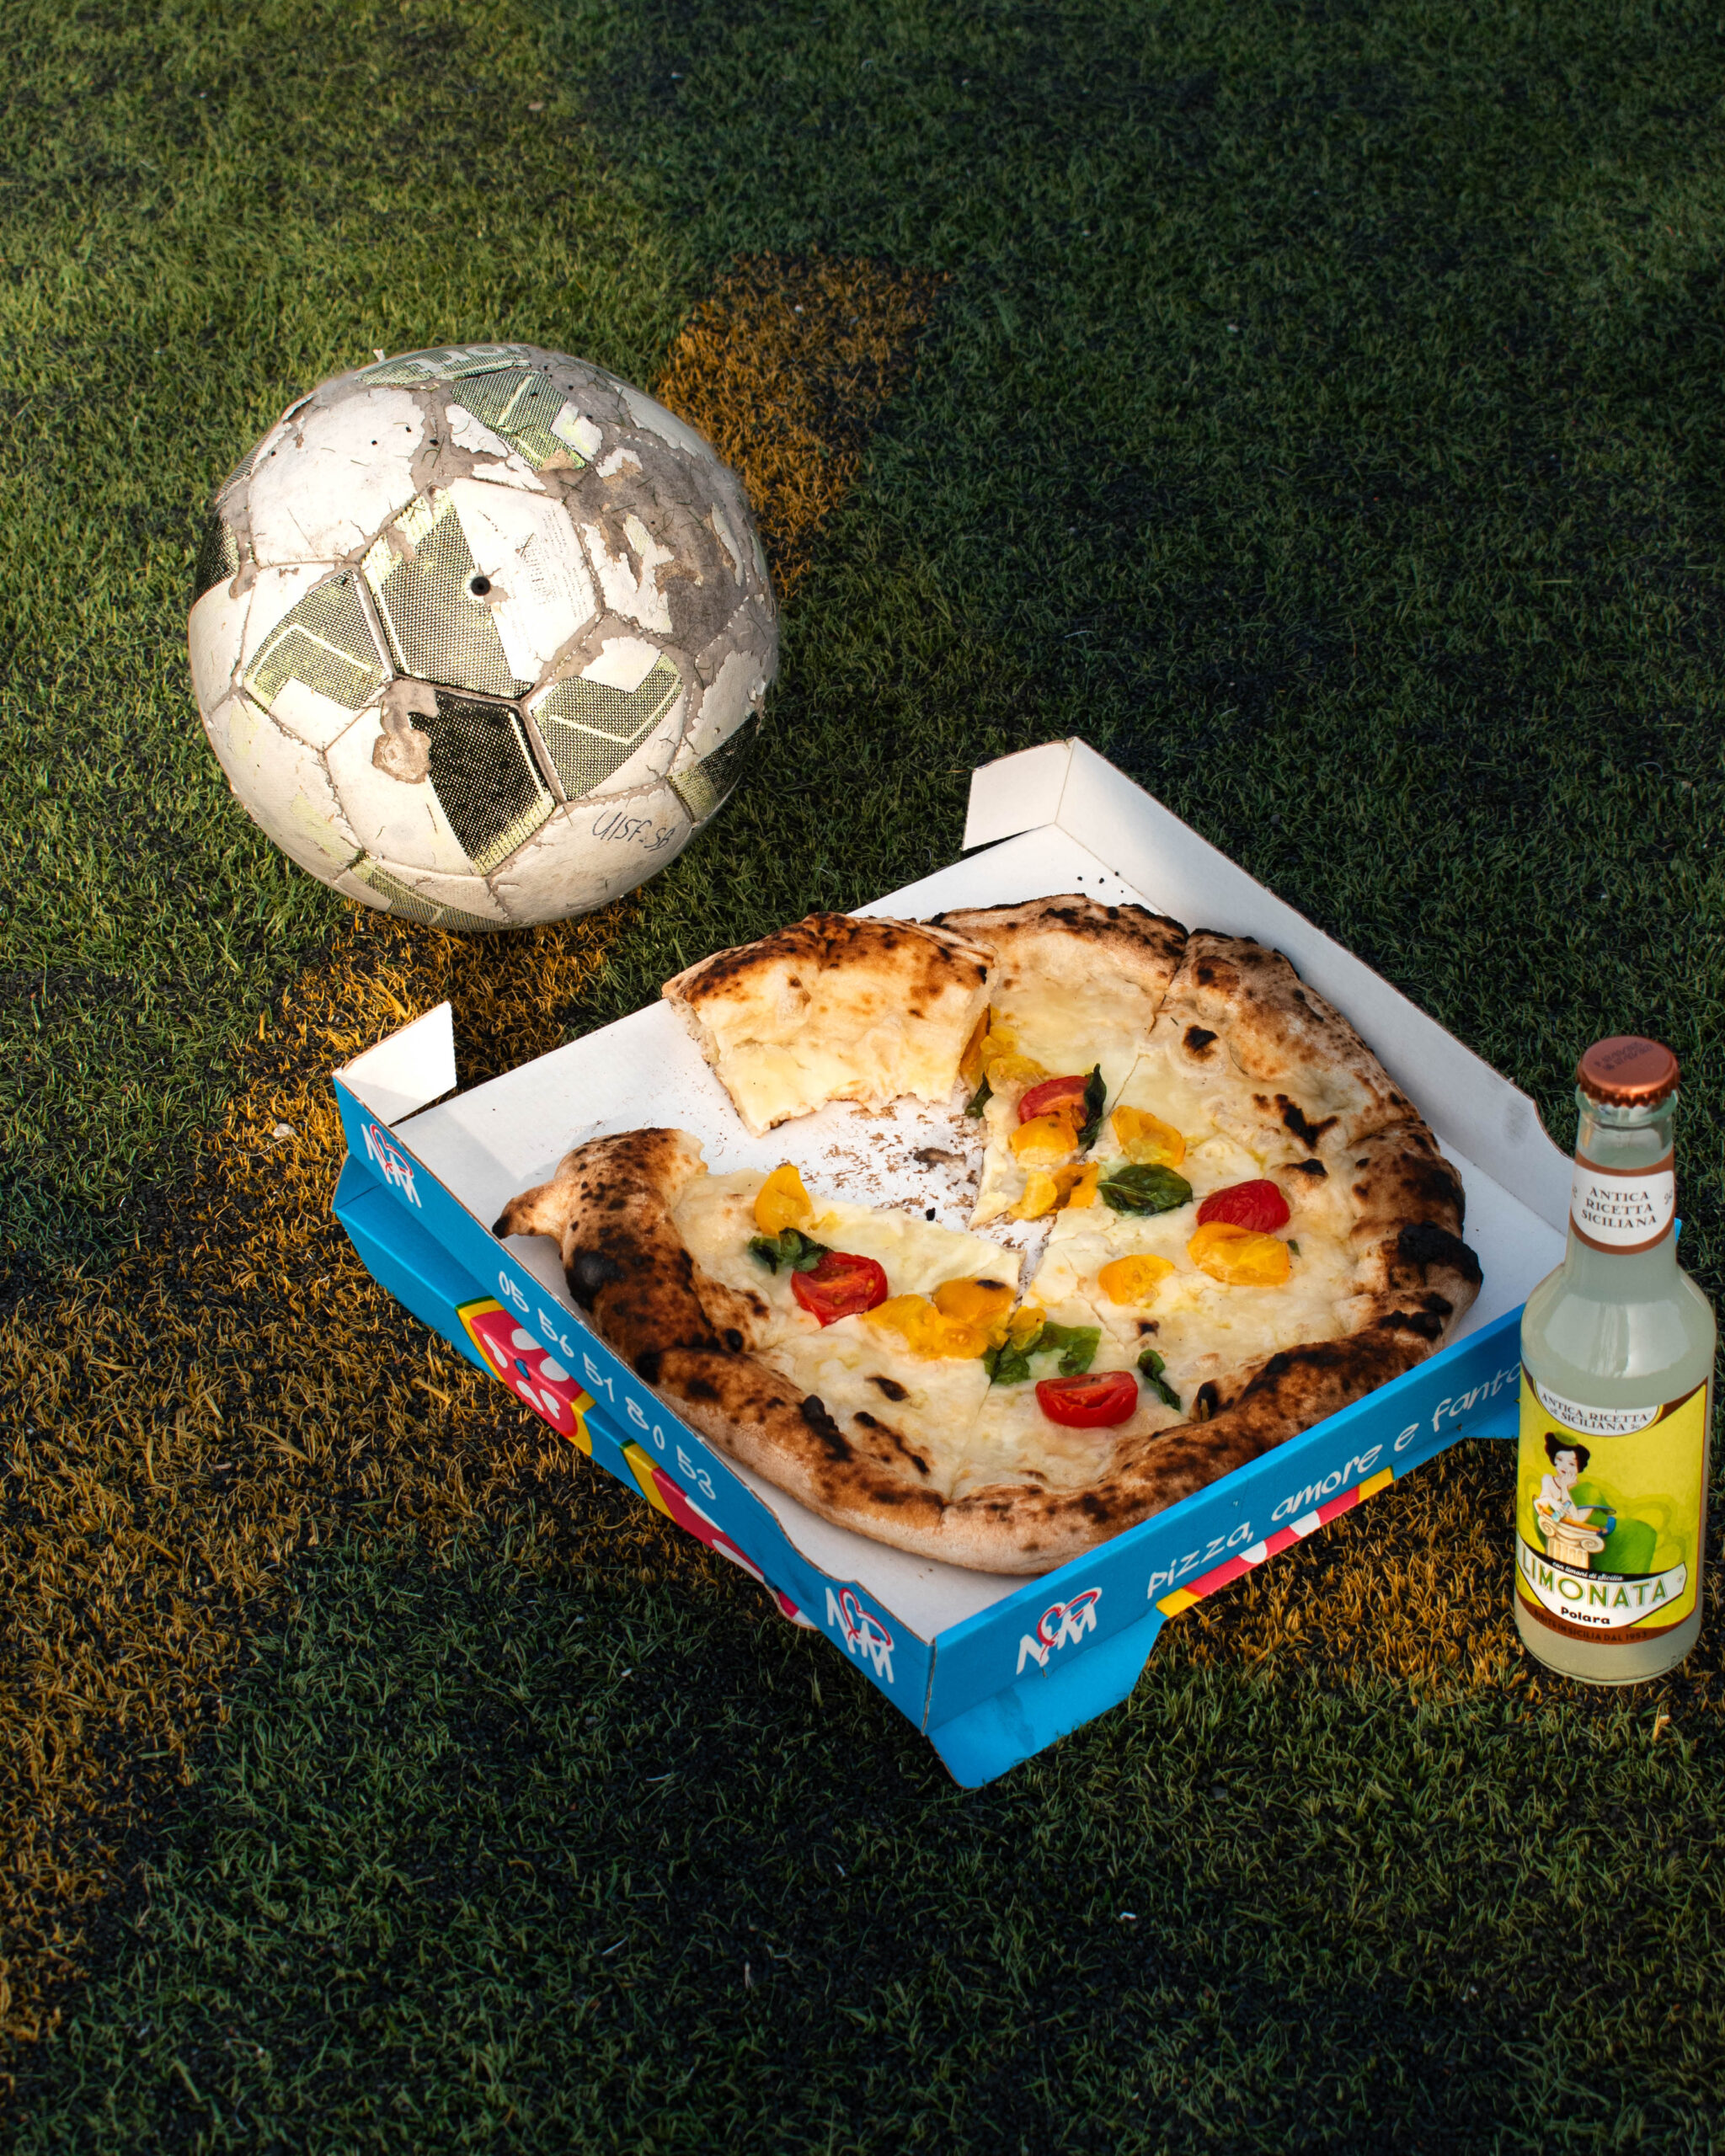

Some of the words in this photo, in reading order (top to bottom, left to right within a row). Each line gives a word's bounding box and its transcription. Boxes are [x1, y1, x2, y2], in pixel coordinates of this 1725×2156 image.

[1589, 1186, 1649, 1202] ANTICA
[1585, 1198, 1653, 1214] RICETTA
[1581, 1209, 1657, 1228] SICILIANA
[499, 1271, 530, 1313] 05
[538, 1308, 574, 1358] 56
[583, 1353, 615, 1402] 51
[625, 1396, 665, 1450] 80
[676, 1445, 717, 1500] 53
[1541, 1393, 1583, 1418] ANTICA
[1589, 1412, 1648, 1423] RICETTA
[1560, 1412, 1626, 1432] SICILIANA
[1271, 1444, 1383, 1522] amore
[1394, 1422, 1420, 1453] e
[1521, 1546, 1668, 1608] LIMONATA
[1560, 1606, 1610, 1625] Polara
[1568, 1626, 1601, 1641] SICILIA
[1603, 1633, 1623, 1641] DAL
